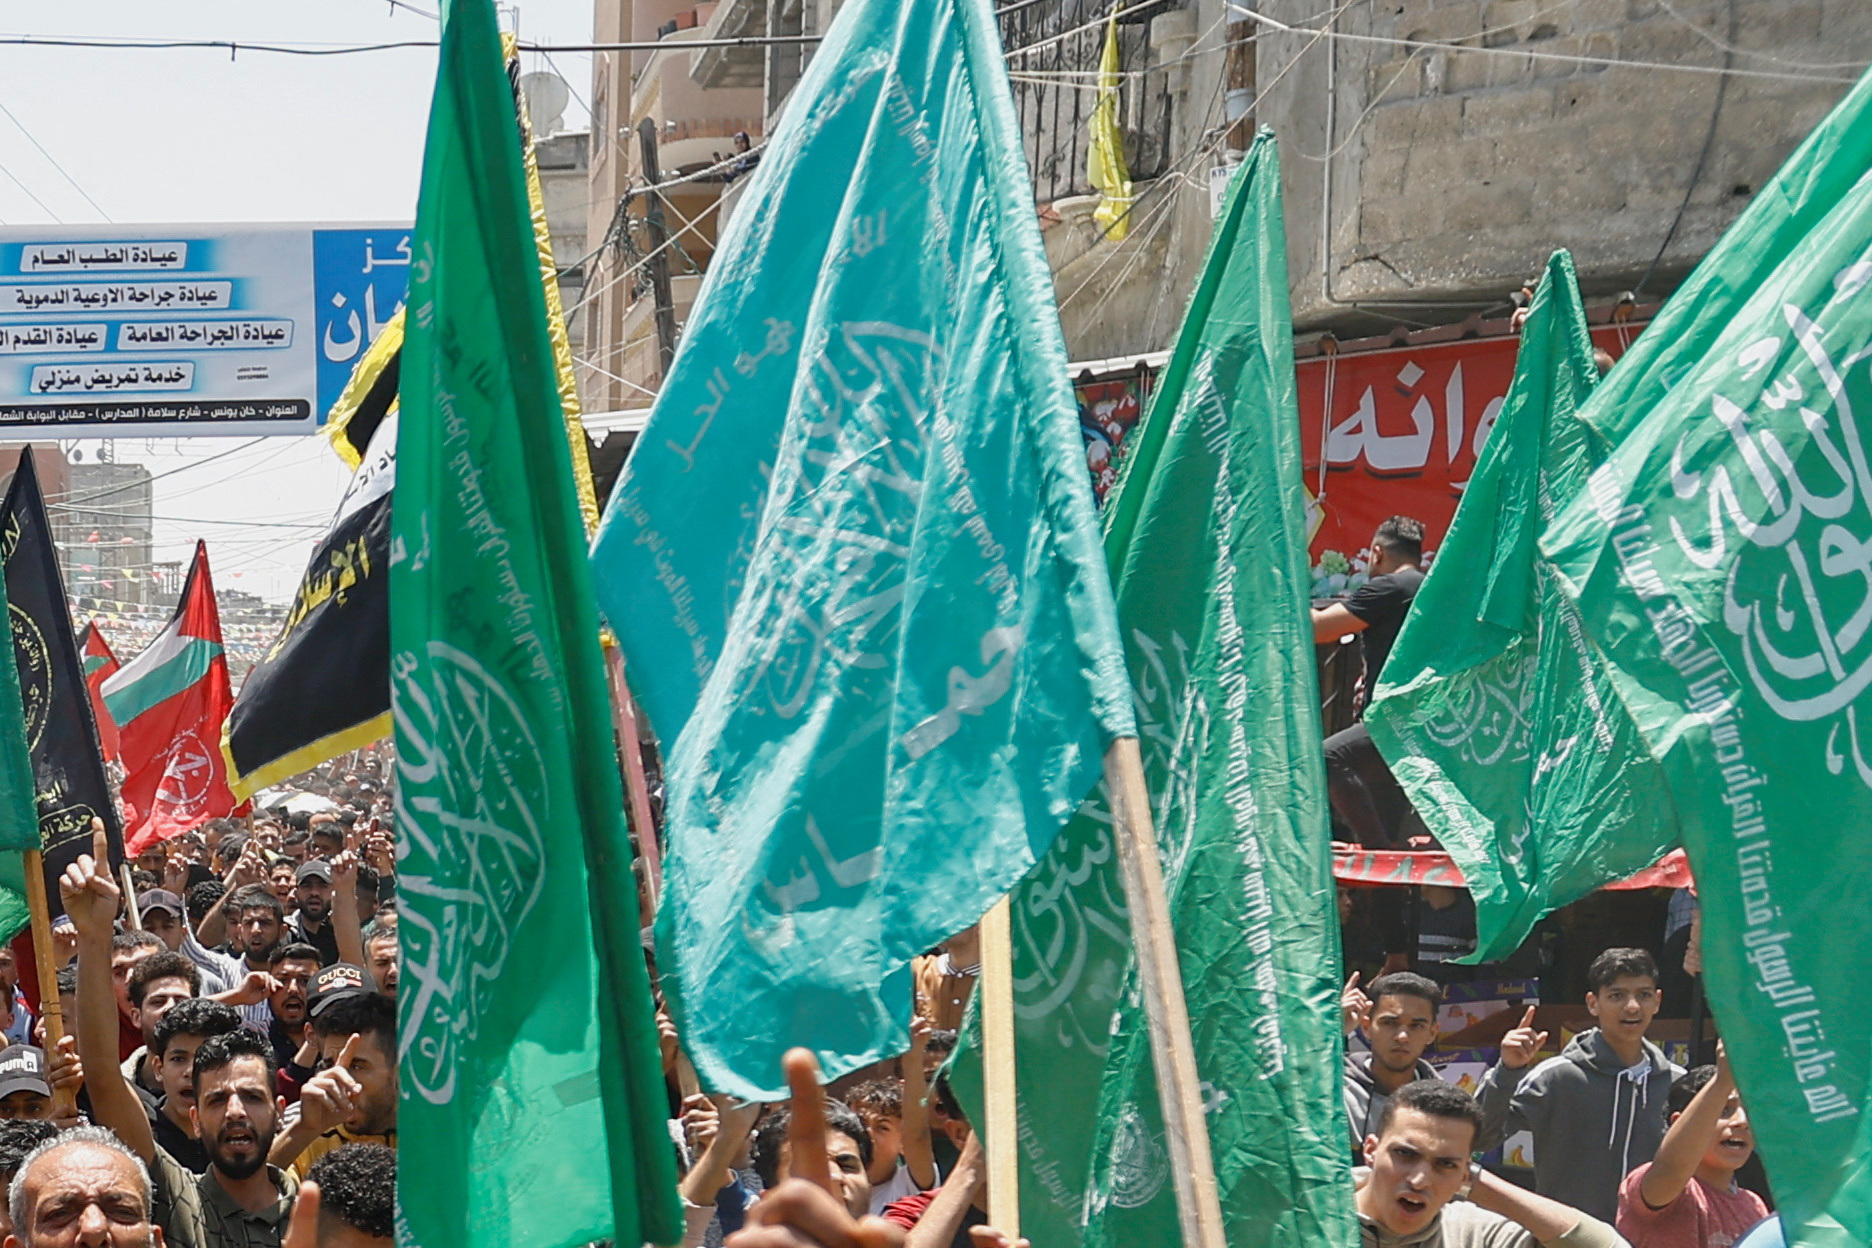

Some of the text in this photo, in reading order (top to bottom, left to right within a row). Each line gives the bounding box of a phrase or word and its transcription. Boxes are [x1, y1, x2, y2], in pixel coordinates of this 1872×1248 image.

[31, 247, 178, 270] عيادة الطب العام
[362, 236, 412, 274] كز
[15, 289, 69, 309] الدموية
[128, 287, 175, 306] جراحة
[178, 286, 218, 306] عيادة
[12, 328, 52, 350] القدم
[56, 327, 99, 349] عيادة
[126, 323, 285, 346] عيادة الجراحة العامة
[38, 366, 186, 393] خدمة تمريض منزلي
[26, 409, 56, 423] البوابة
[58, 409, 86, 422] مقابل
[146, 406, 177, 418] سلامة
[178, 405, 201, 420] شارع
[210, 407, 238, 419] يونس
[240, 405, 256, 418] خان
[265, 404, 297, 420] العنوان
[1737, 841, 1785, 929] قدوتنا
[317, 966, 361, 986] GUCCI
[1742, 930, 1816, 1012] الرسول
[1780, 1008, 1833, 1085] غايتنا
[1807, 1090, 1858, 1125] الله
